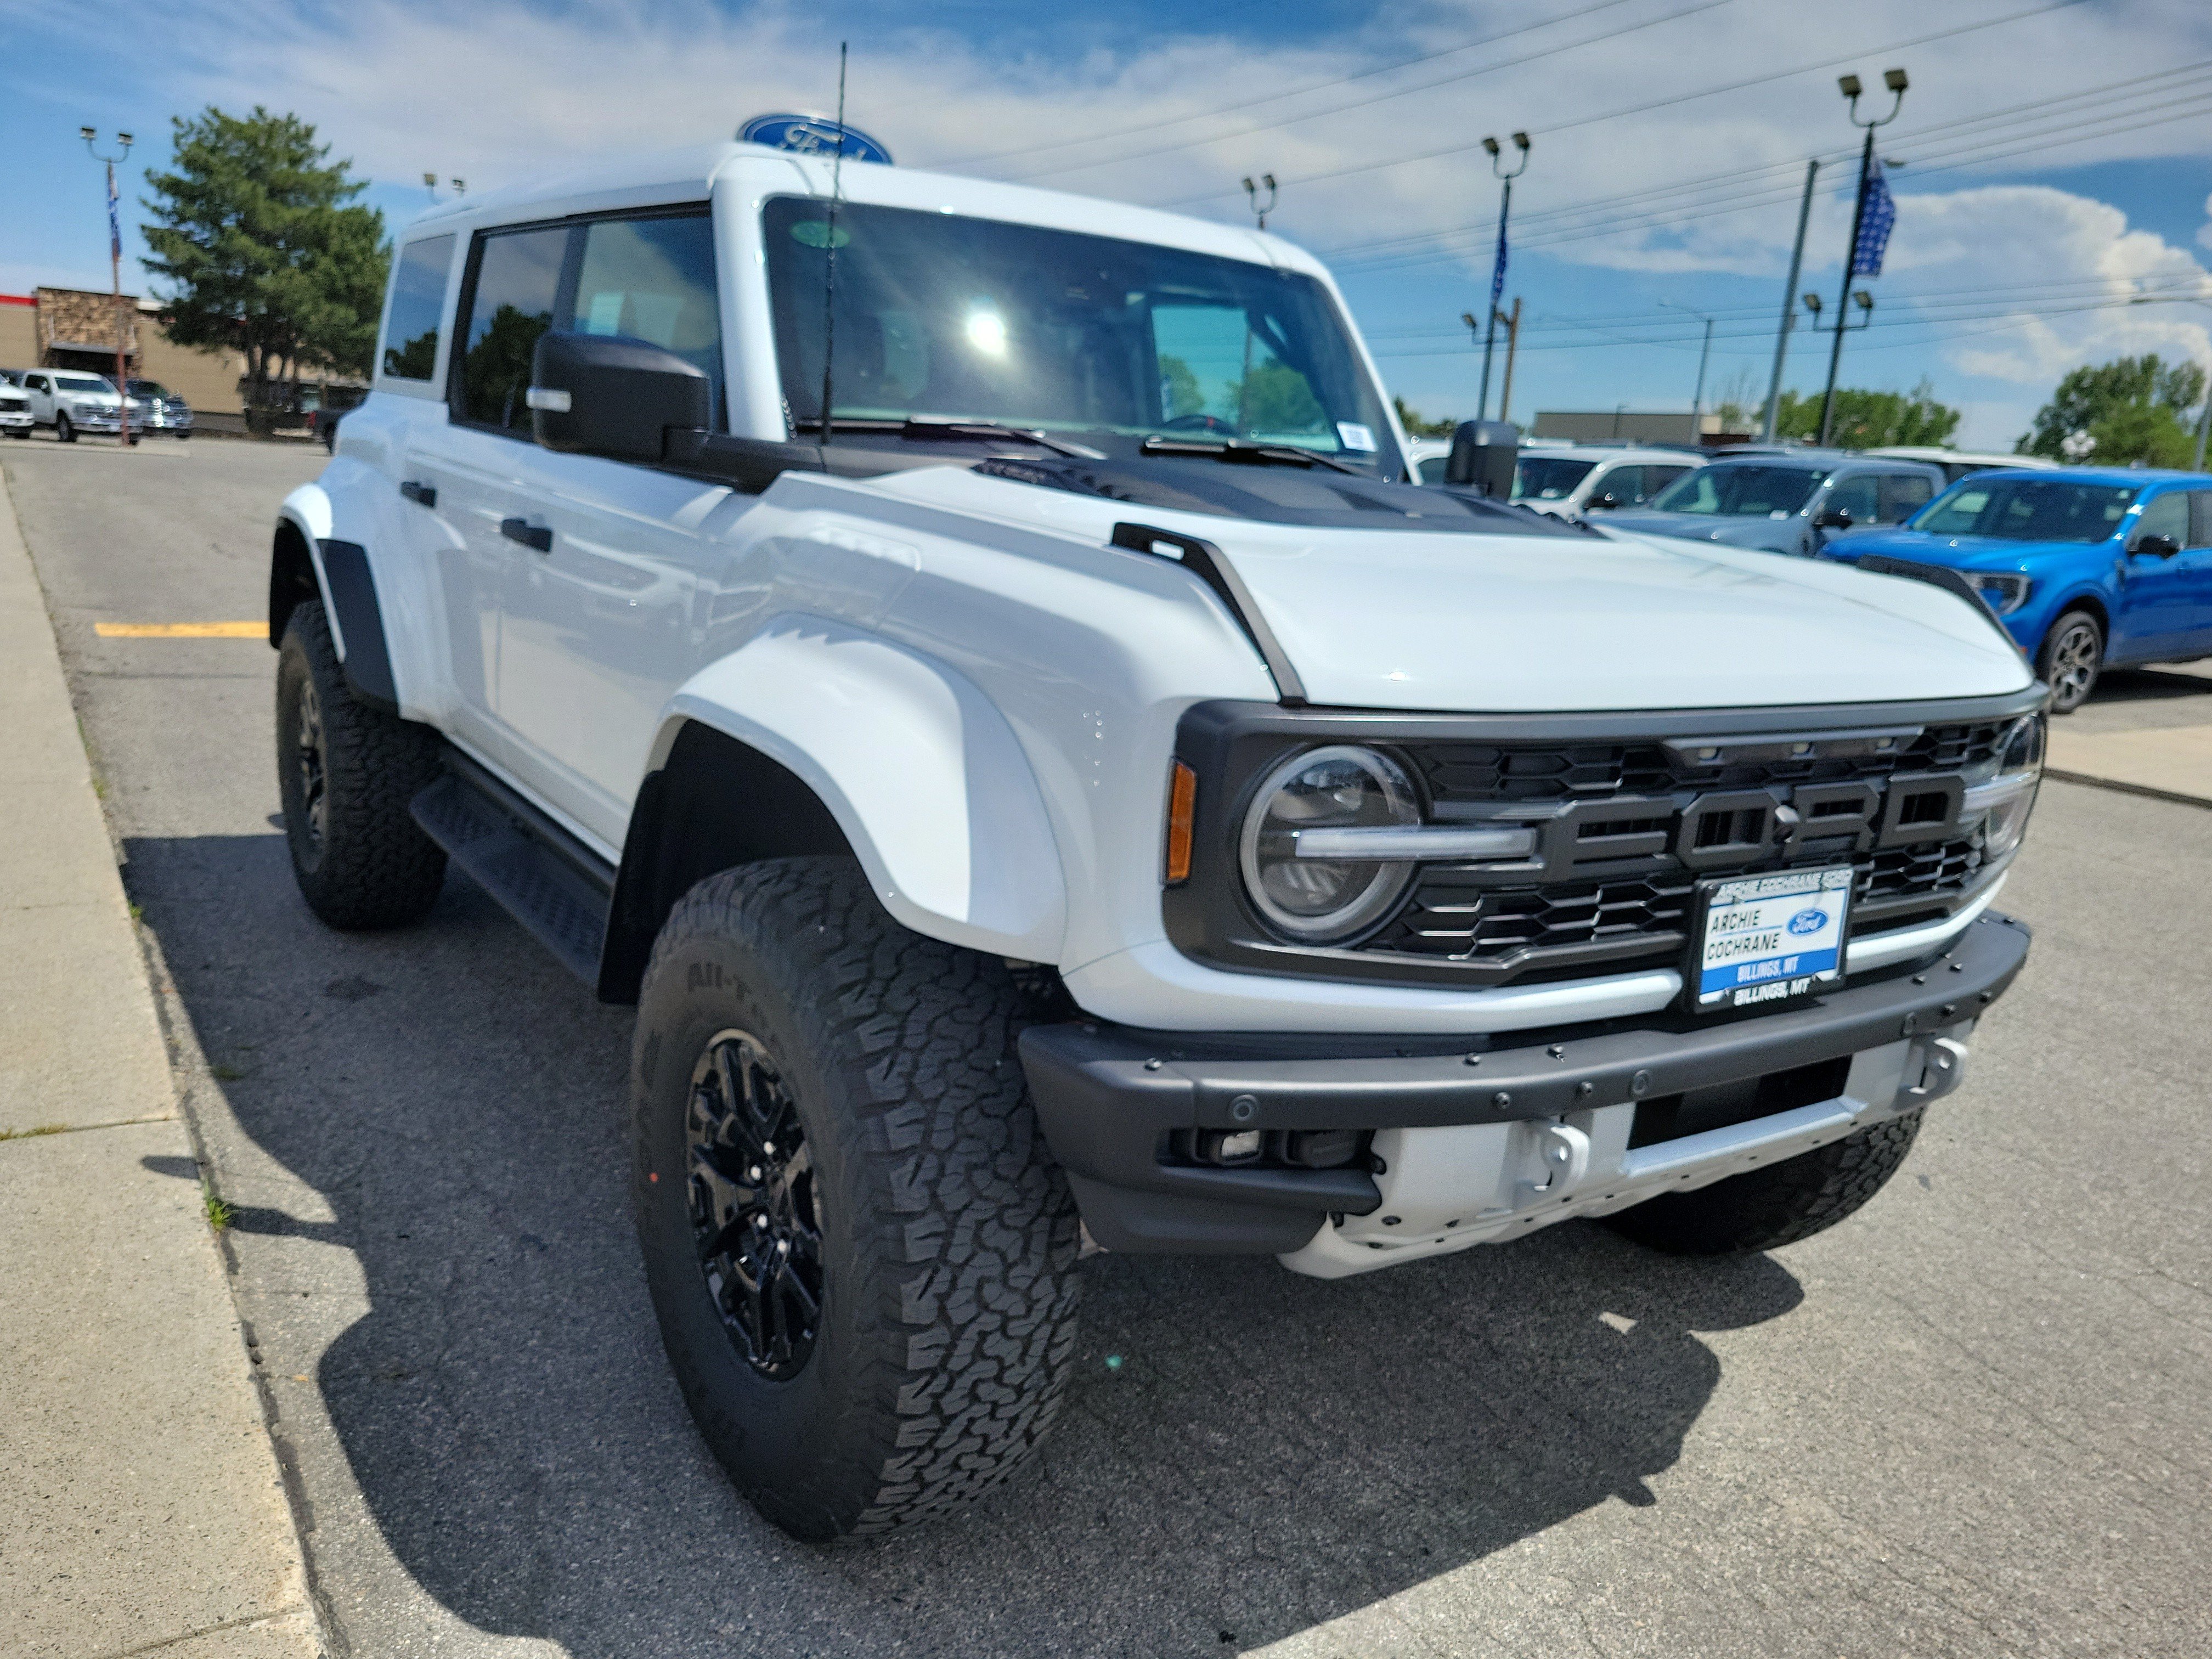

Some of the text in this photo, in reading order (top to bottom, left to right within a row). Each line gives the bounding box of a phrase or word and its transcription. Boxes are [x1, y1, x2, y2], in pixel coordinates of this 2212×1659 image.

[1544, 772, 1965, 883] FORD
[1710, 910, 1761, 933] ARCHIE
[1707, 933, 1780, 960] COCHRANE
[1736, 955, 1800, 983] BILLINGS, MT
[1734, 977, 1810, 1006] BILLINGS, MT
